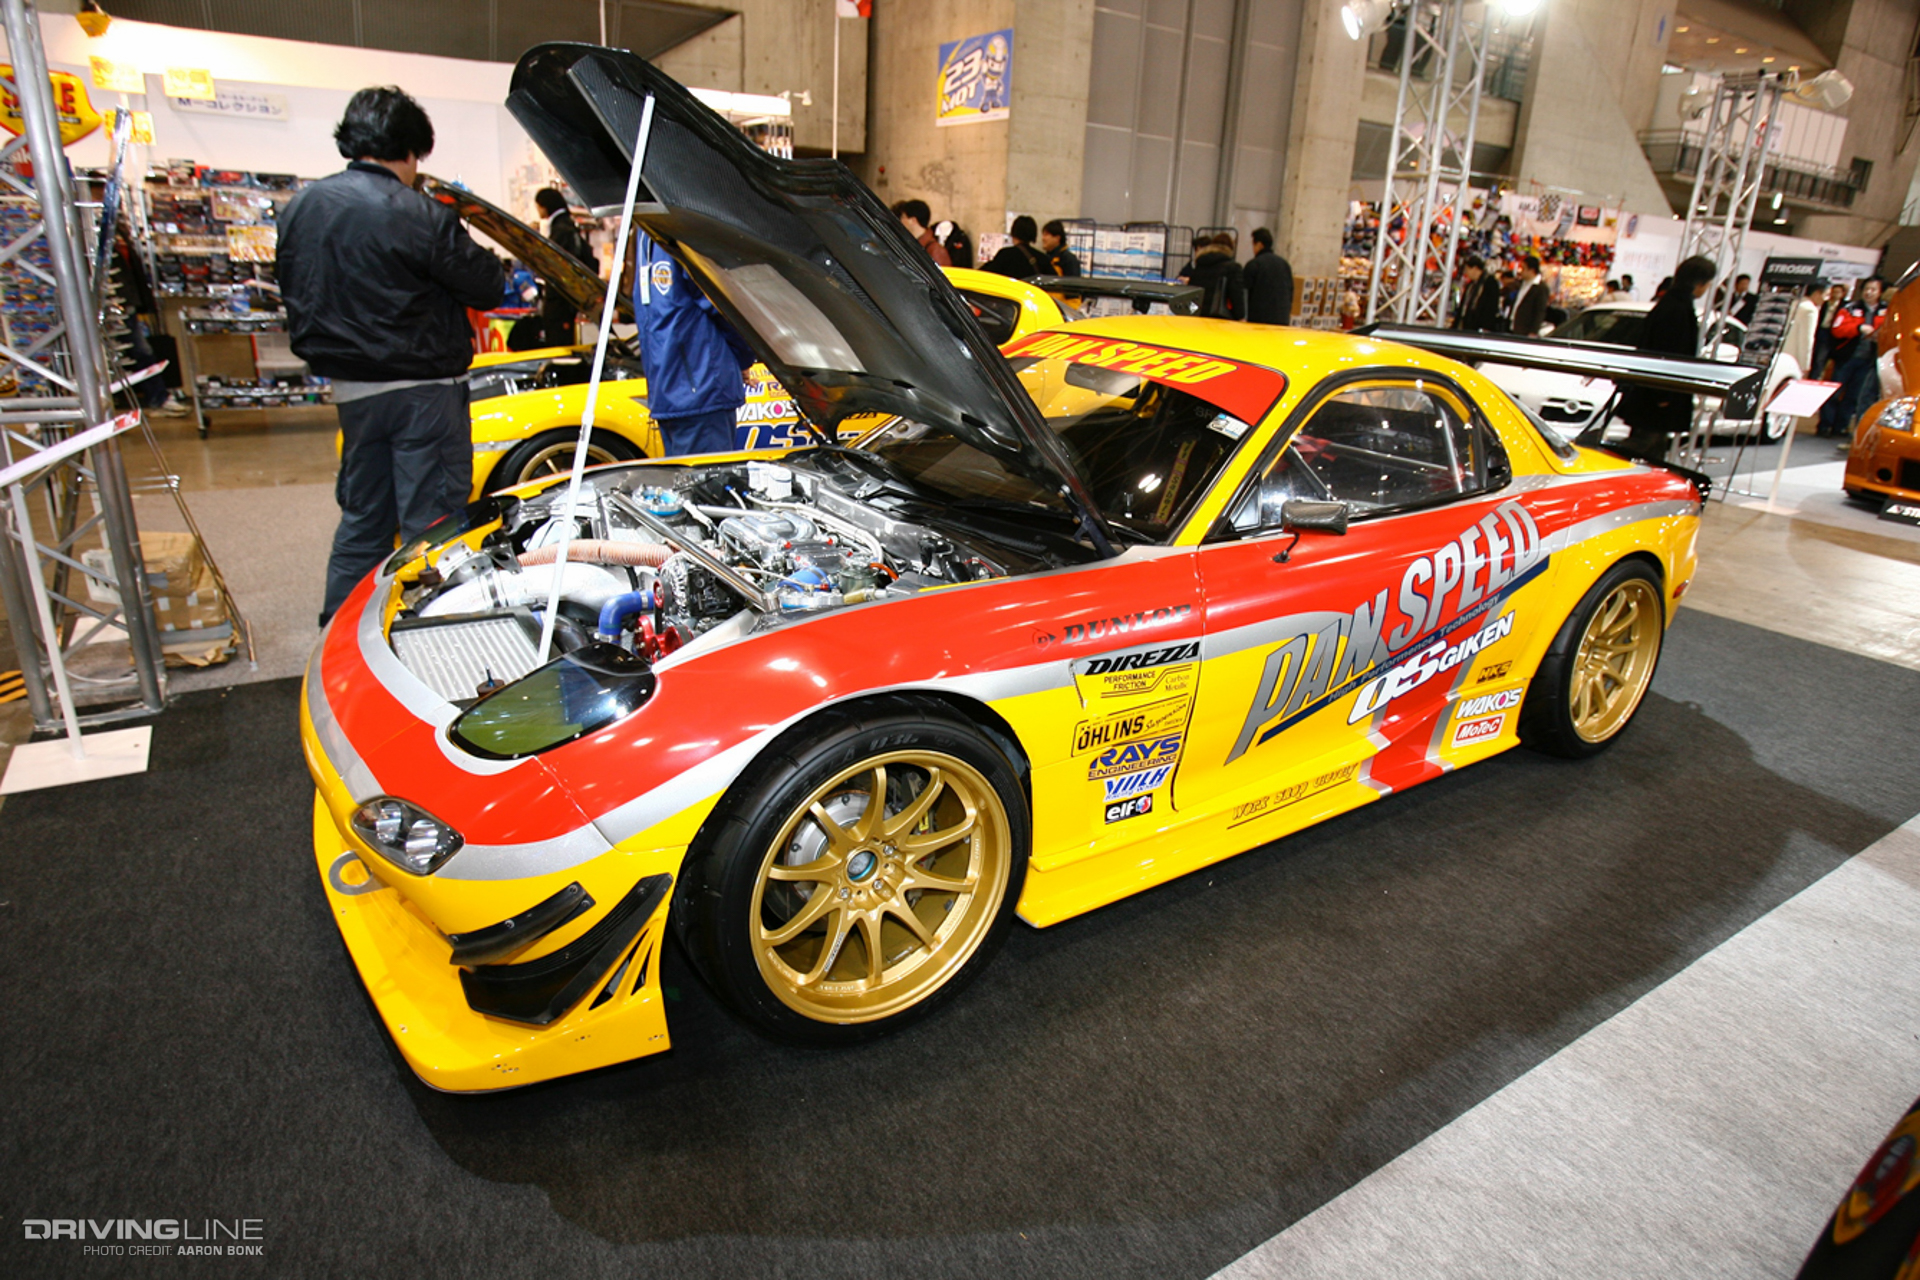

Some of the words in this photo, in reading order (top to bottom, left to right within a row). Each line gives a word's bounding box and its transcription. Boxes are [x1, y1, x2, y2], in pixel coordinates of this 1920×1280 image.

[943, 48, 983, 94] 23
[1767, 263, 1817, 275] STROSEK
[1004, 333, 1105, 359] PAN
[1078, 342, 1239, 384] SPEED
[1061, 603, 1192, 645] DUNLOP
[1224, 588, 1389, 766] PAN
[1387, 500, 1541, 652] SPEED
[1084, 641, 1200, 676] DIREZZA
[1327, 680, 1358, 703] High
[1360, 635, 1436, 683] Performance
[1438, 594, 1501, 638] Technology
[1103, 671, 1156, 684] PERFORMANCE
[1112, 681, 1147, 691] FRICTION
[1077, 715, 1145, 751] ÖHLINS
[1088, 755, 1177, 778] ENGINEERING
[1090, 735, 1182, 769] RAYS
[1106, 800, 1136, 820] elf
